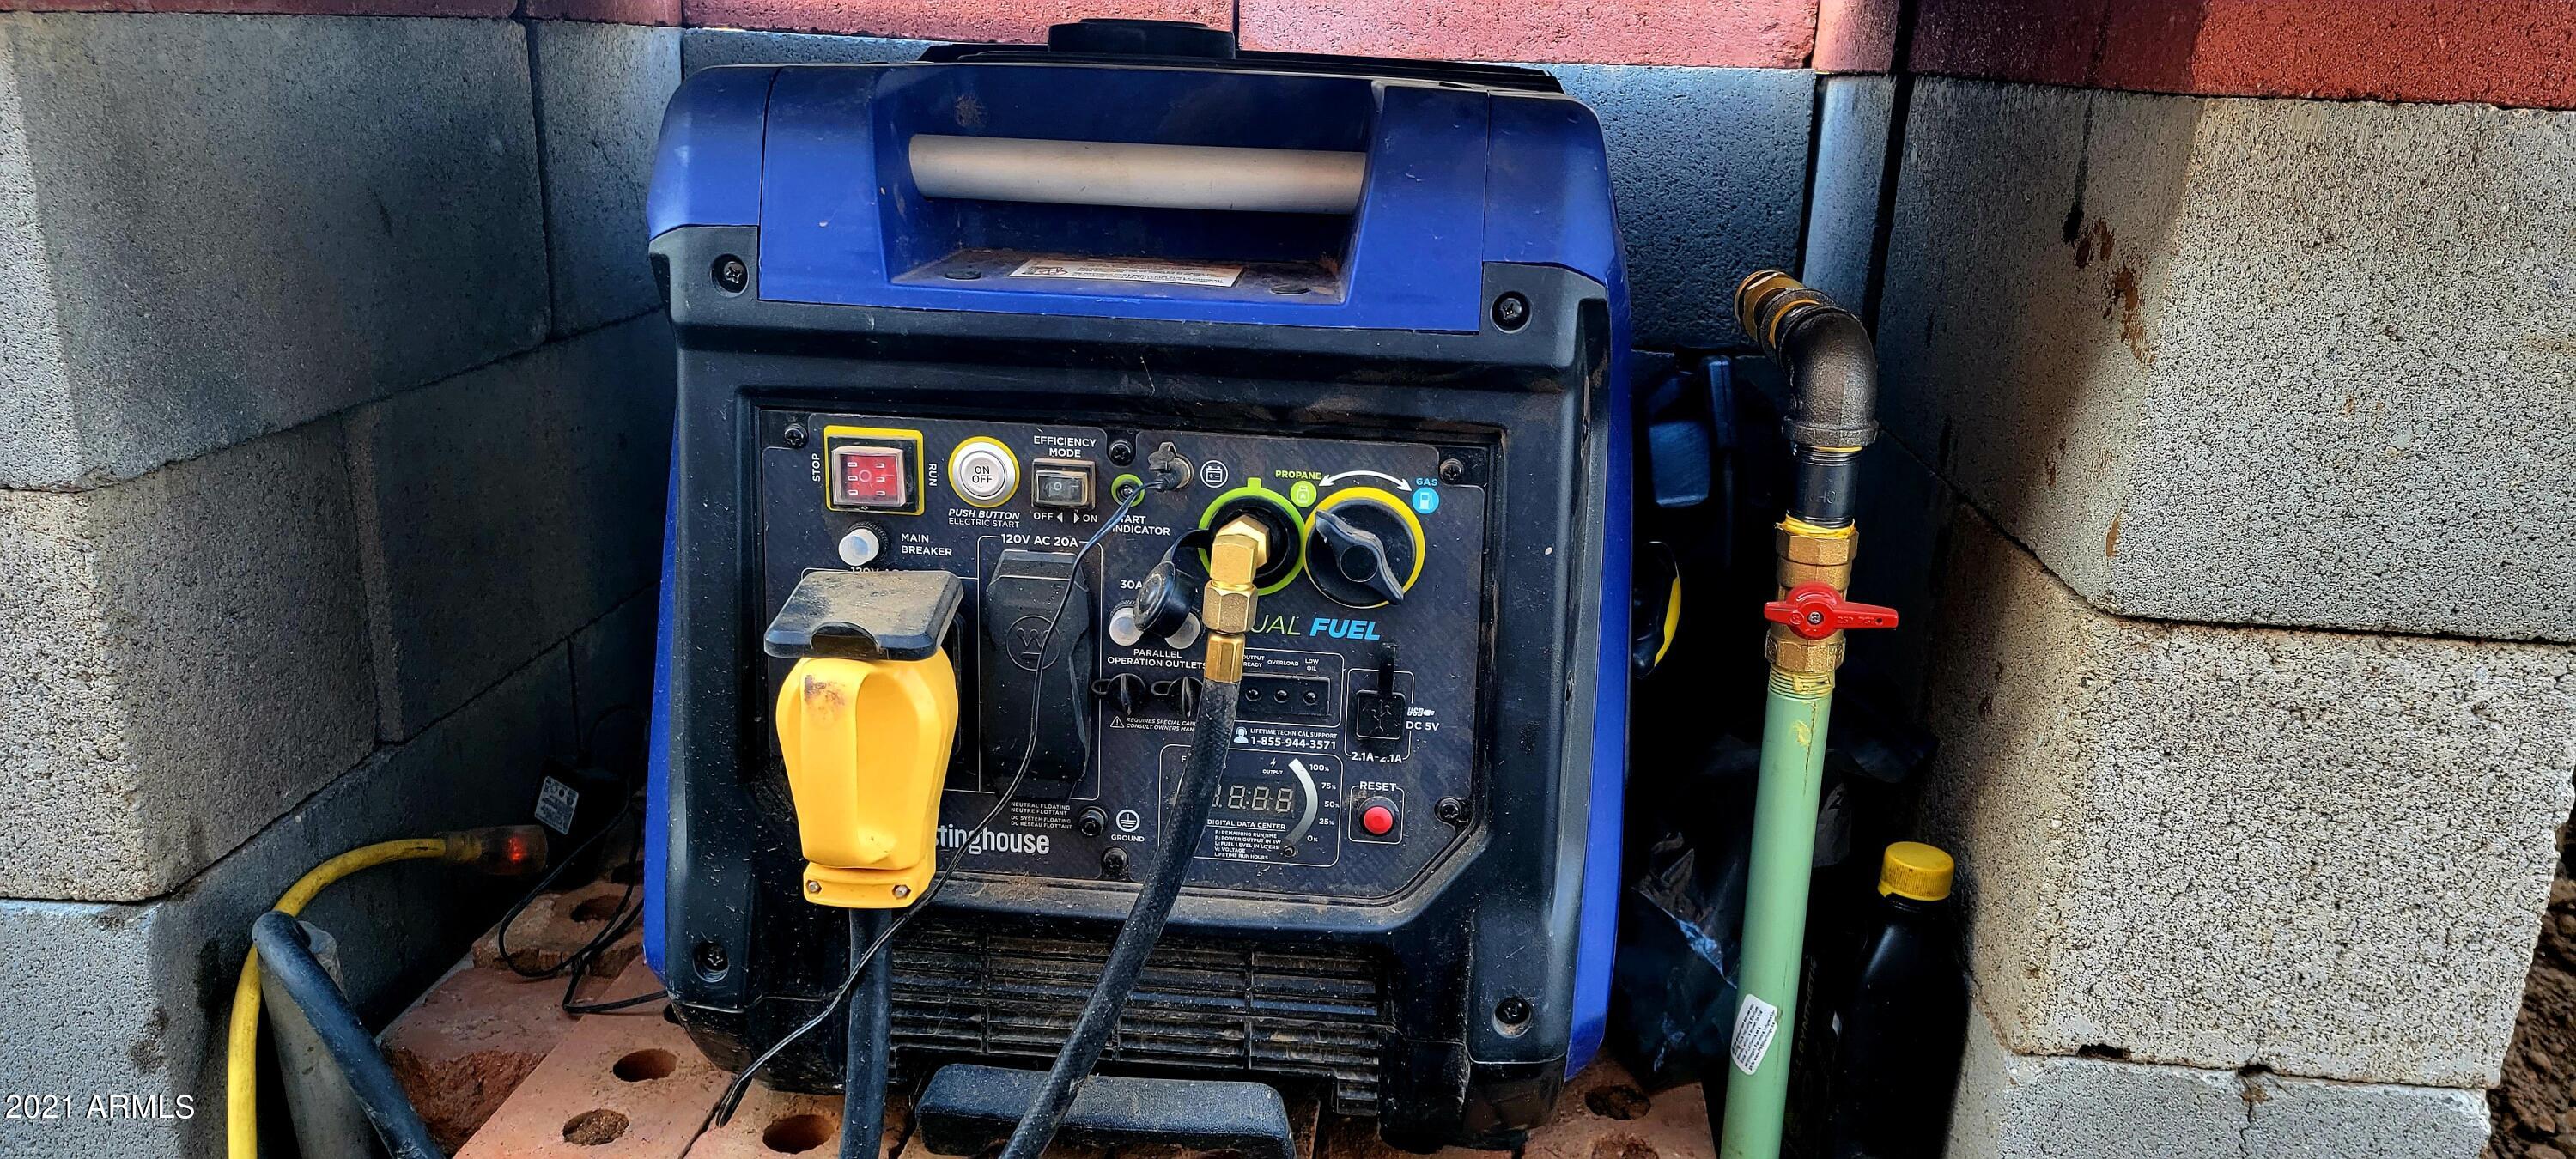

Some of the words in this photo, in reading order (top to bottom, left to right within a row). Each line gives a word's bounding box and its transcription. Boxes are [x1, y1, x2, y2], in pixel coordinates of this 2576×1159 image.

[1033, 435, 1097, 447] EFFICIENCY
[1049, 448, 1081, 458] MODE
[811, 452, 821, 482] STOP
[974, 465, 990, 475] ON
[928, 463, 938, 487] RUN
[972, 475, 993, 483] OFF
[1275, 470, 1322, 481] PROPANE
[1416, 477, 1438, 487] GAS
[948, 508, 980, 518] PUSH
[981, 510, 1020, 520] BUTTON
[1083, 514, 1097, 523] ON
[948, 517, 990, 526] ELECTRIC
[992, 519, 1020, 528] START
[901, 533, 929, 543] MAIN
[1000, 533, 1030, 544] 120V
[1033, 536, 1051, 546] AC
[1054, 537, 1078, 548] 20A
[901, 545, 952, 556] BREAKER
[1120, 580, 1143, 590] 30A
[1250, 614, 1302, 636] UAL
[1309, 617, 1382, 640] FUEL
[1133, 648, 1182, 659] PARALLEL
[1107, 656, 1163, 668] OPERATION
[1406, 707, 1424, 717] USB
[1406, 720, 1422, 730] DC
[1425, 722, 1440, 731] 5V
[1250, 736, 1337, 750] 1-855-944-3571
[1309, 763, 1330, 772] 100%
[1359, 780, 1397, 792] RESET
[1110, 834, 1145, 843] GROUND
